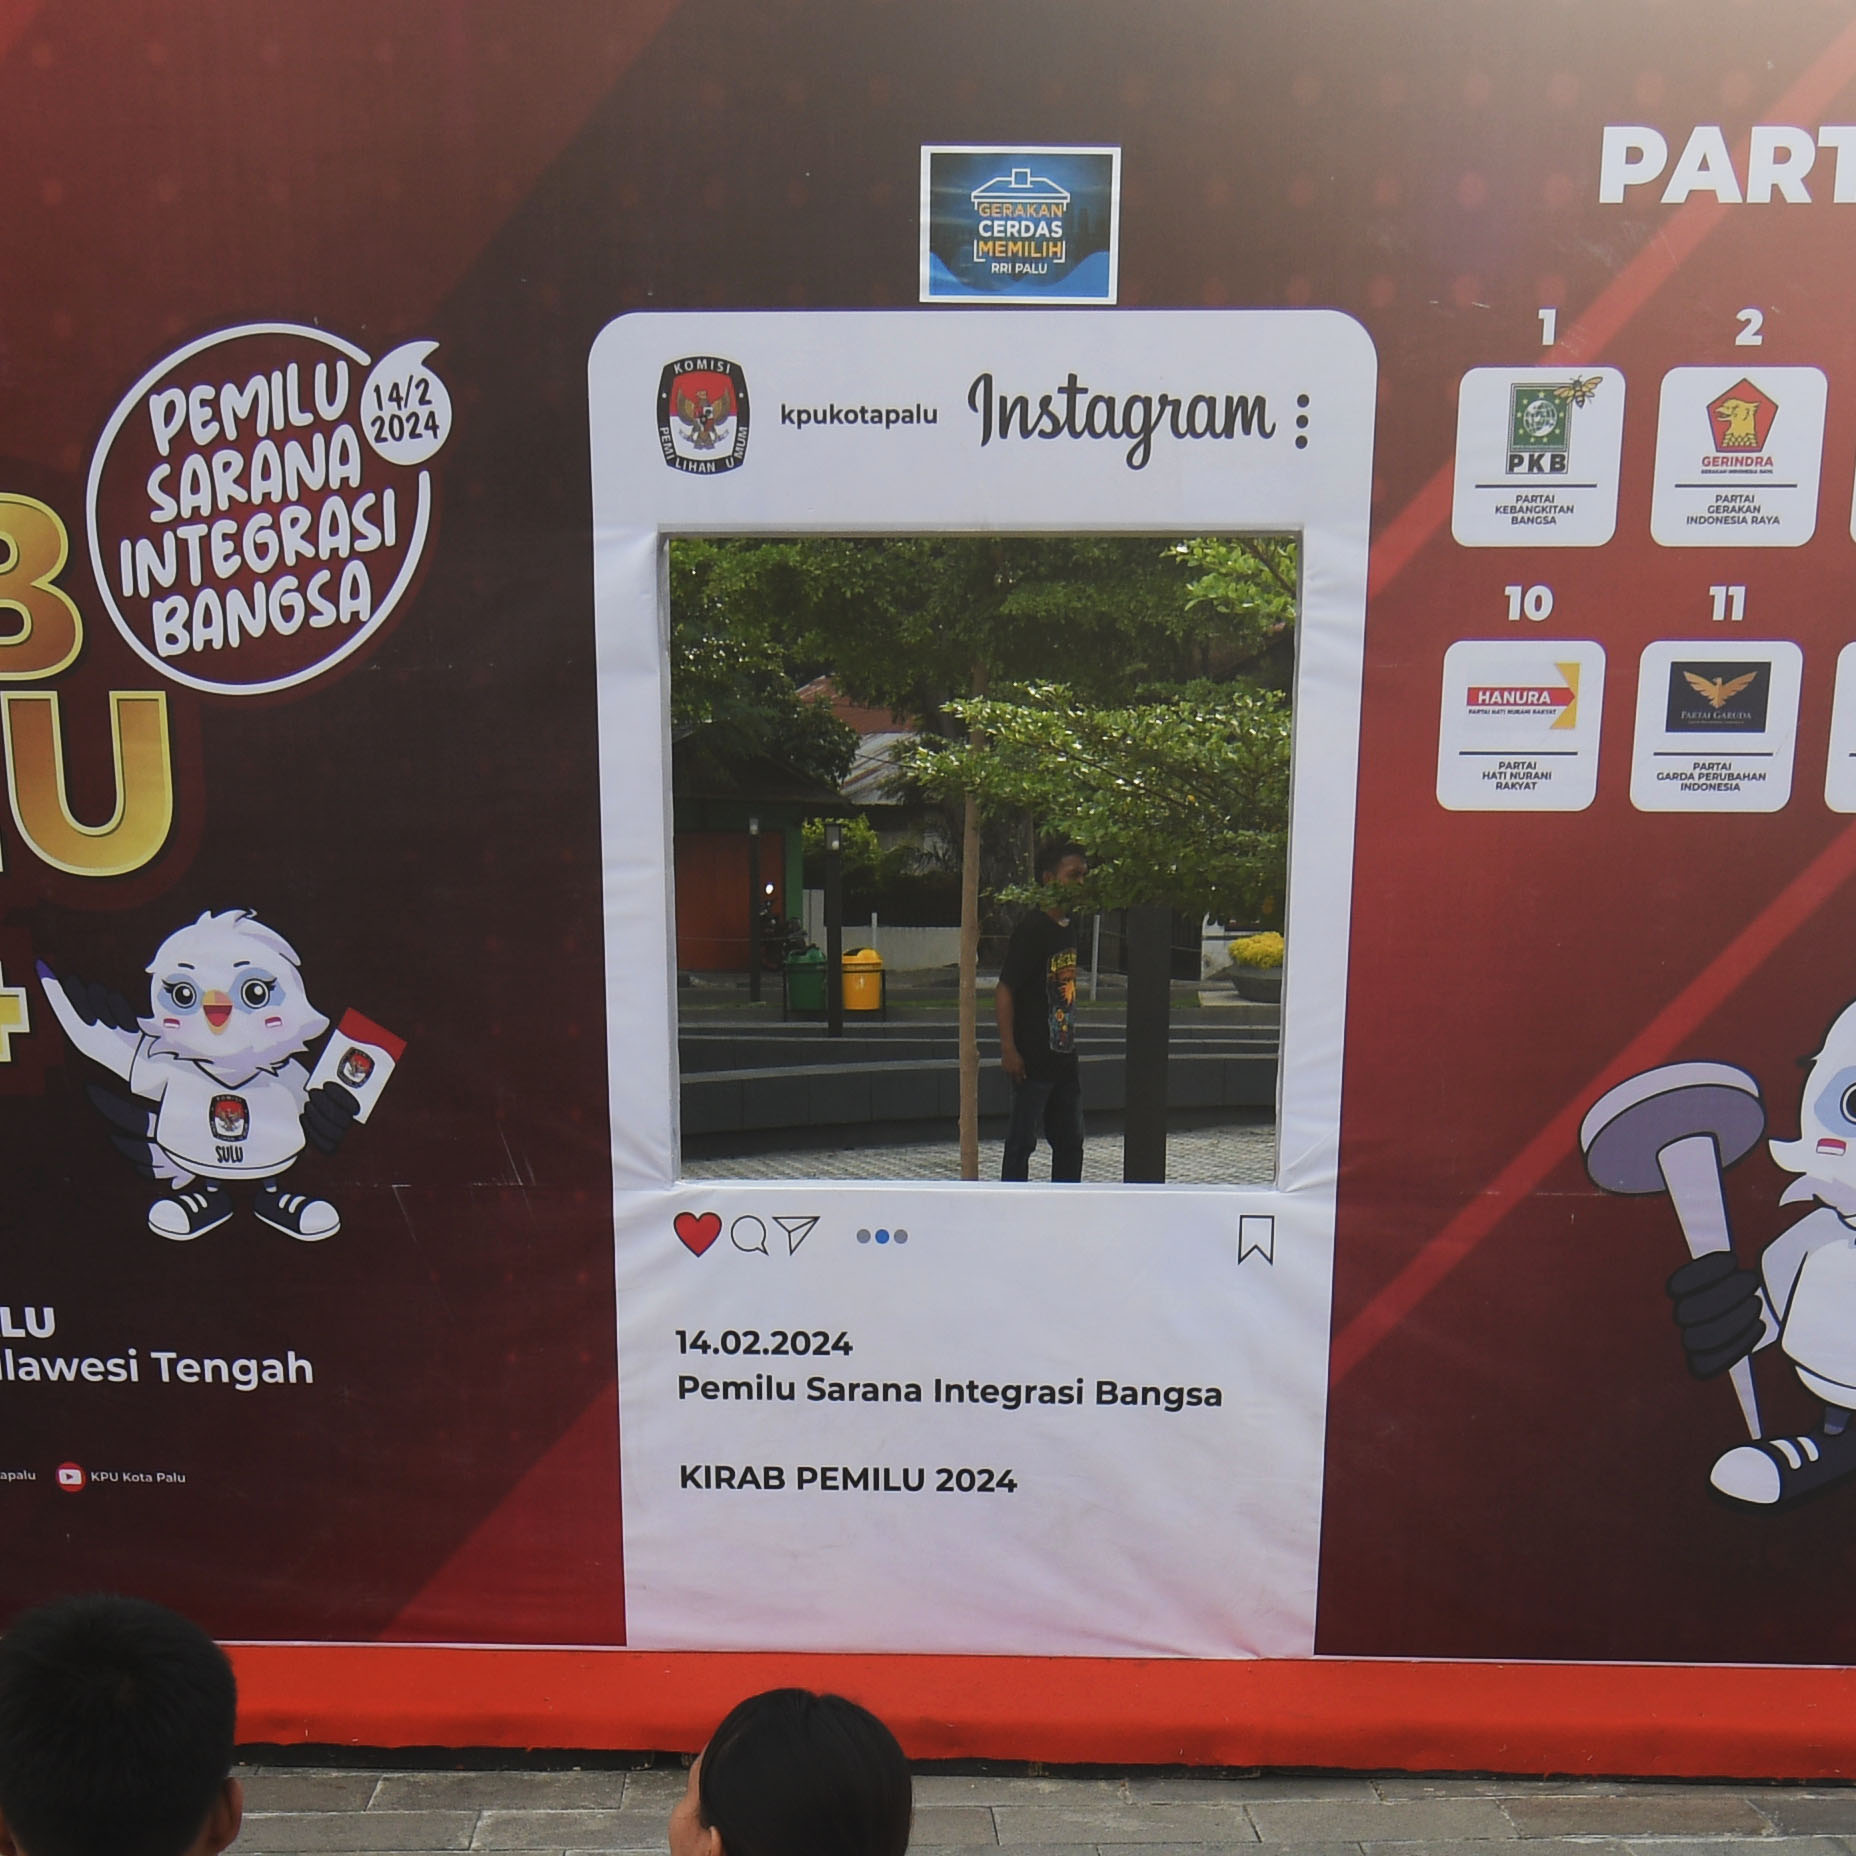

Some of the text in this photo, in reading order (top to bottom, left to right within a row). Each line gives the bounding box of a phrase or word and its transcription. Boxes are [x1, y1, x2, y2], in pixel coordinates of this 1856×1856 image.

[979, 203, 1063, 218] GERAKAN
[978, 221, 1063, 238] CERDAS
[978, 240, 1062, 257] MEMILIH
[991, 263, 1048, 274] RRI PALU
[1538, 308, 1557, 346] 1
[1735, 308, 1764, 346] 2
[672, 358, 732, 375] KOMISI
[373, 375, 433, 411] 14/2
[149, 360, 348, 456] PEMILU
[370, 412, 440, 444] 2024
[780, 373, 1276, 471] kpukotapalu Instagram
[1508, 453, 1568, 473] PKB
[1701, 456, 1774, 468] GERINDRA
[146, 425, 362, 524] SARANA
[1495, 505, 1575, 515] KEBANGKITAN
[1707, 505, 1761, 514] GERAKAN
[1510, 515, 1557, 525] BANGSA
[1686, 515, 1781, 525] INDONESIA RAYA
[120, 489, 397, 598] INTEGRASI
[151, 560, 372, 657] BANGSA
[1504, 585, 1554, 622] 10
[1709, 585, 1746, 621] 11
[1478, 690, 1551, 704] HANURA
[1482, 771, 1552, 780] HATI NURANI
[1656, 772, 1766, 781] GARDA PERUBAHAN
[1495, 781, 1537, 791] RAKYAT
[1680, 782, 1740, 792] INDONESIA
[216, 1145, 244, 1164] SULU
[675, 1329, 854, 1357] 14.02.2024
[150, 1351, 314, 1391] Tengah
[678, 1374, 1223, 1412] Pemilu Sarana Integrasi Bangsa
[91, 1471, 186, 1484] KPU Kota Palu
[679, 1464, 1017, 1494] KIRAB PEMILU 2024
